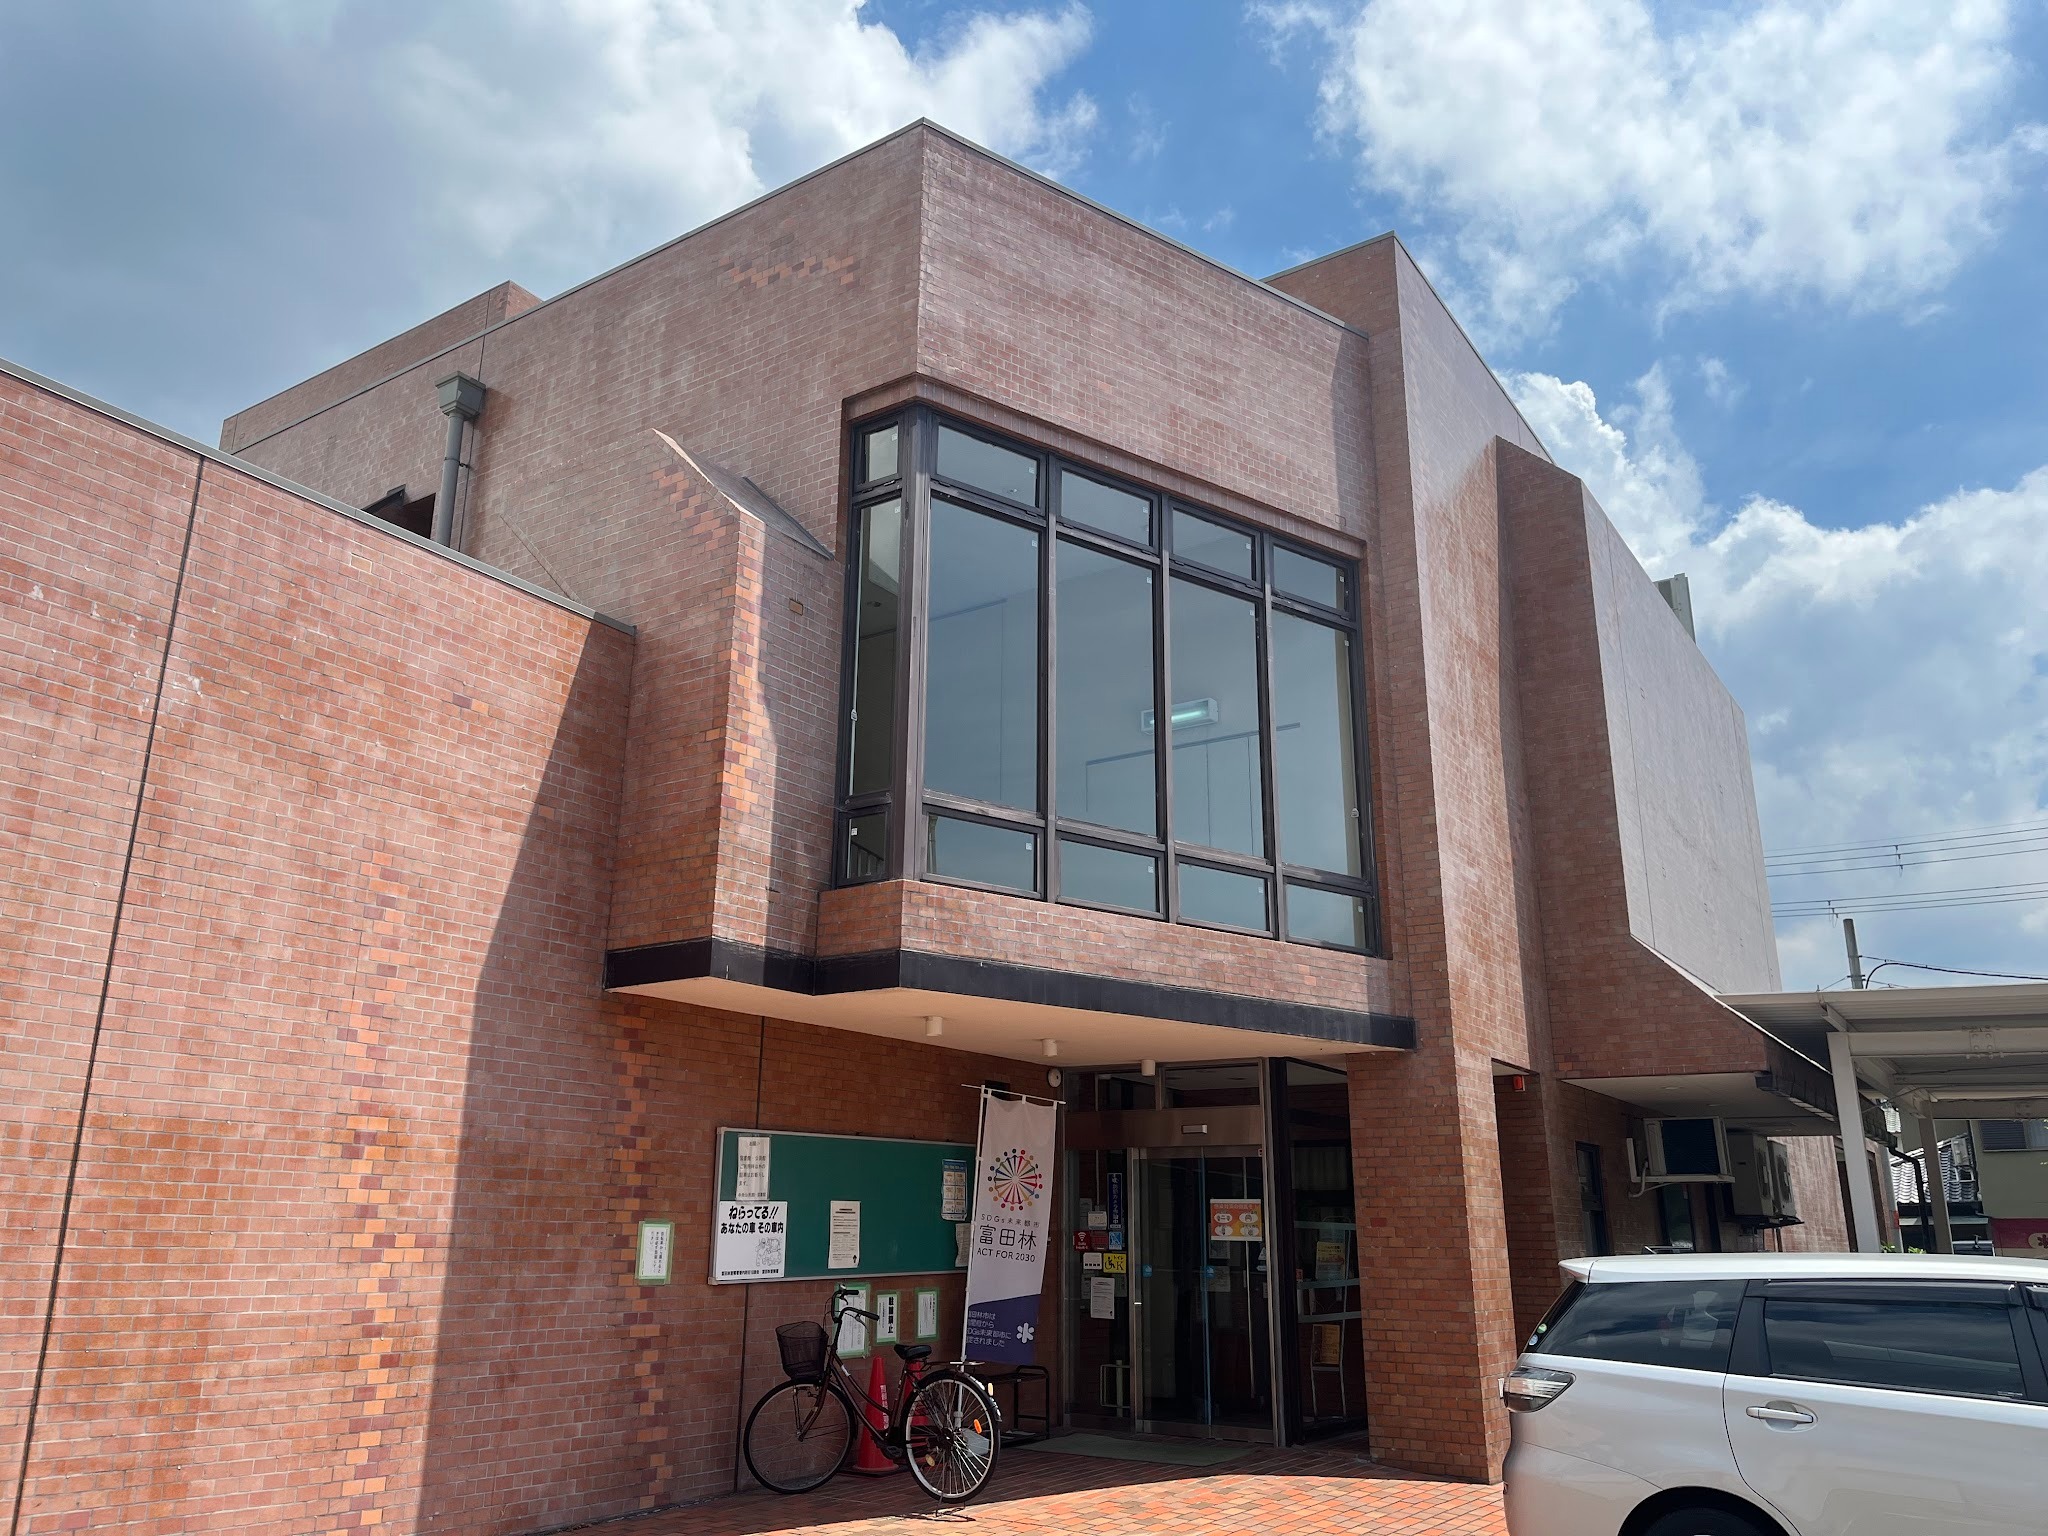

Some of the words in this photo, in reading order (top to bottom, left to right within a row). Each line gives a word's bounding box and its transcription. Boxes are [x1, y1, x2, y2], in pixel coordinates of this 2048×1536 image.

[728, 1205, 779, 1220] ねらってる!!
[720, 1222, 756, 1234] あなたの車
[758, 1222, 784, 1234] その車内
[981, 1213, 1040, 1229] SDGs未来都市
[979, 1224, 1037, 1250] 富田林
[977, 1247, 993, 1257] ACT
[996, 1250, 1013, 1259] FOR
[1015, 1252, 1036, 1263] 2030
[966, 1327, 1012, 1340] DGs未来都市に
